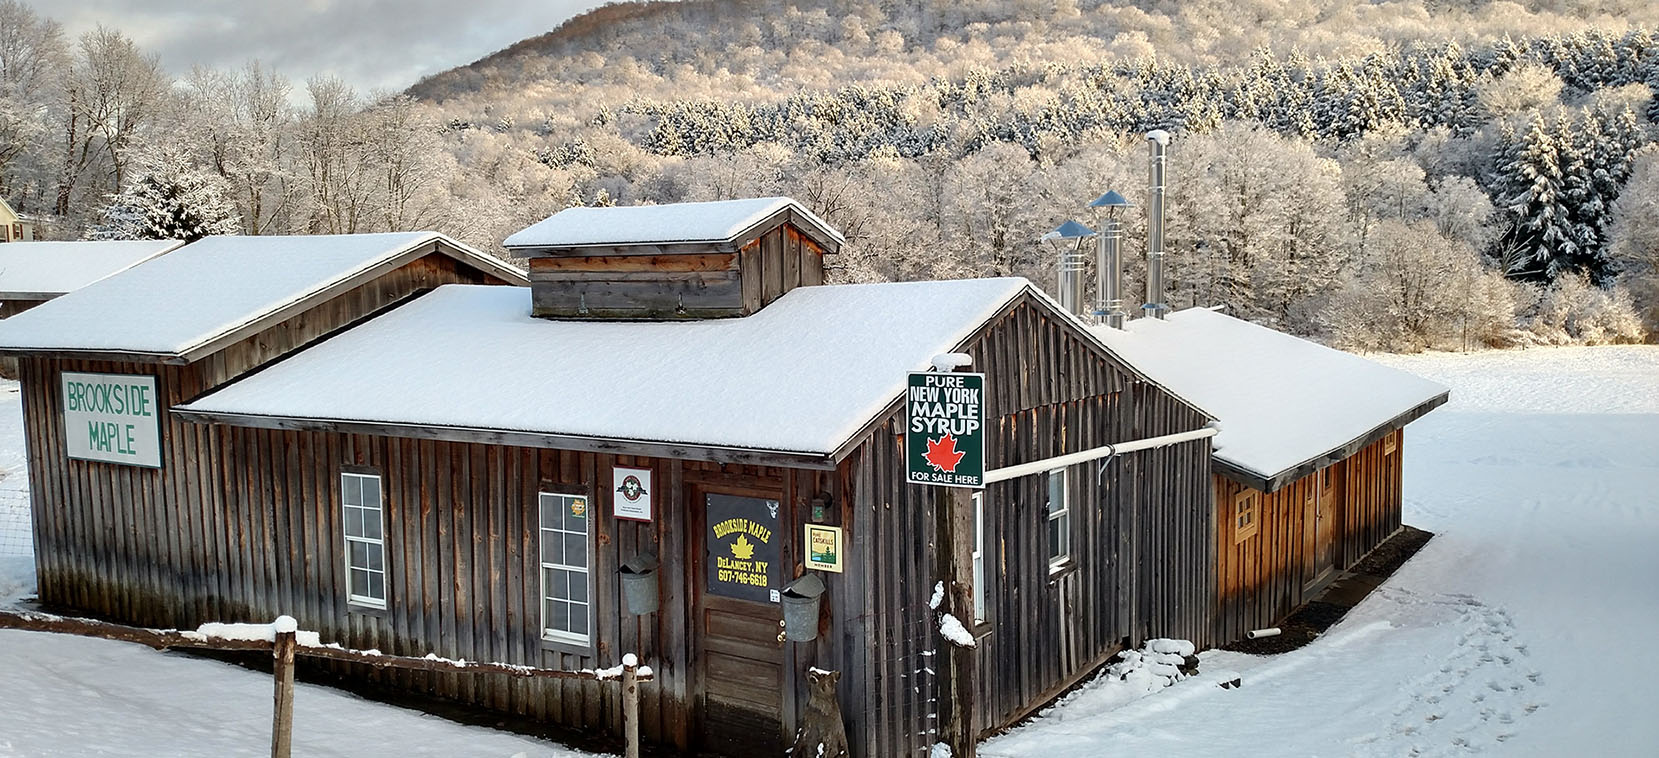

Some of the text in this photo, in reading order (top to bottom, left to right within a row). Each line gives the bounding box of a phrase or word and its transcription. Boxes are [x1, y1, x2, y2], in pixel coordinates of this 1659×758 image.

[925, 375, 964, 388] PURE
[67, 381, 151, 417] BROOKSIDE
[910, 386, 979, 404] NEW YORK
[911, 401, 979, 420] MAPLE
[911, 416, 980, 436] SYRUP
[88, 420, 136, 455] MAPLE
[911, 471, 979, 485] FOR SALE HERE
[712, 518, 772, 544] BROOKSIDE MAPLE
[812, 536, 834, 546] CATSKILLS
[755, 560, 769, 574] NY
[718, 569, 768, 587] 607-746-6618
